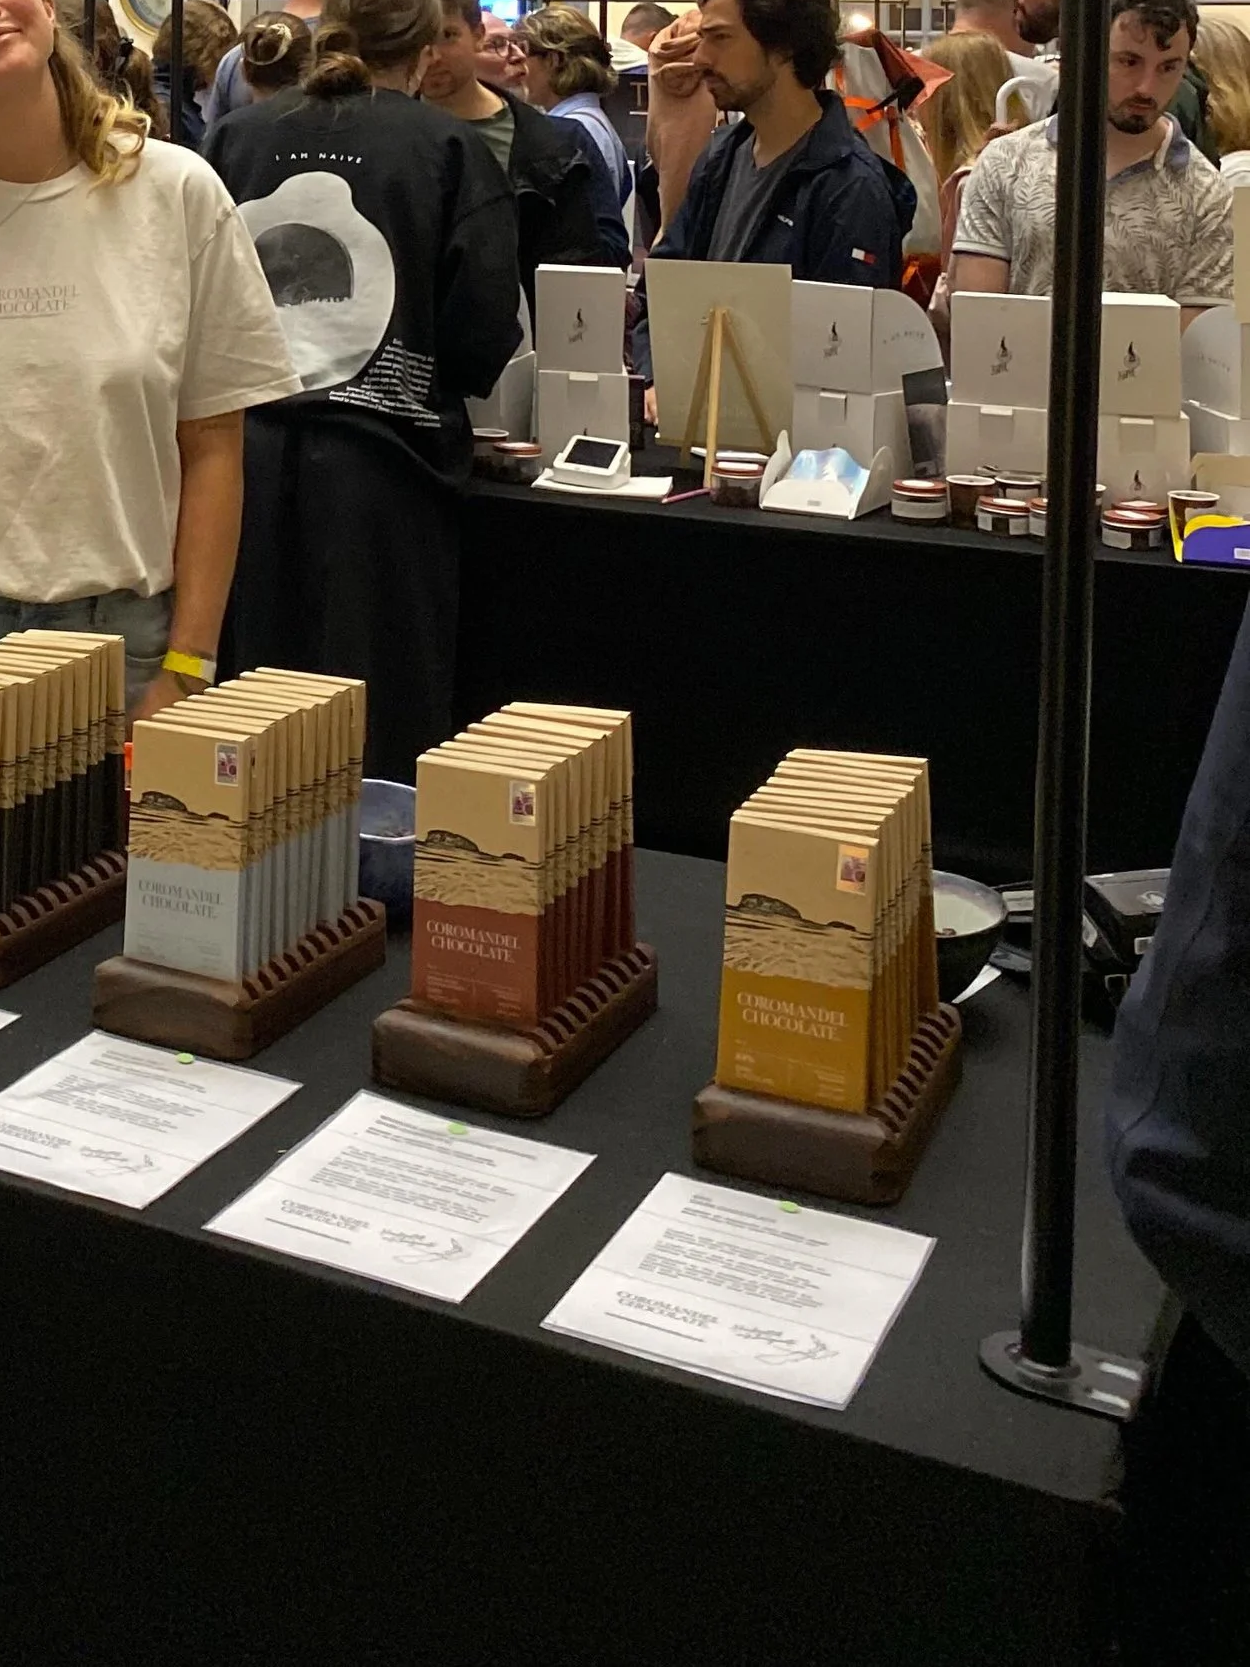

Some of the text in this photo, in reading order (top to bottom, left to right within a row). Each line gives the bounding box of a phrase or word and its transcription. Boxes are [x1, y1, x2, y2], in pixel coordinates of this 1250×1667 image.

[290, 152, 308, 160] AM
[318, 152, 363, 164] NAIVE
[426, 919, 522, 950] COROMANDEL
[431, 935, 516, 964] CHOCOLATE
[736, 991, 850, 1027] COROMANDEL
[742, 1008, 844, 1042] CHOCOLATE
